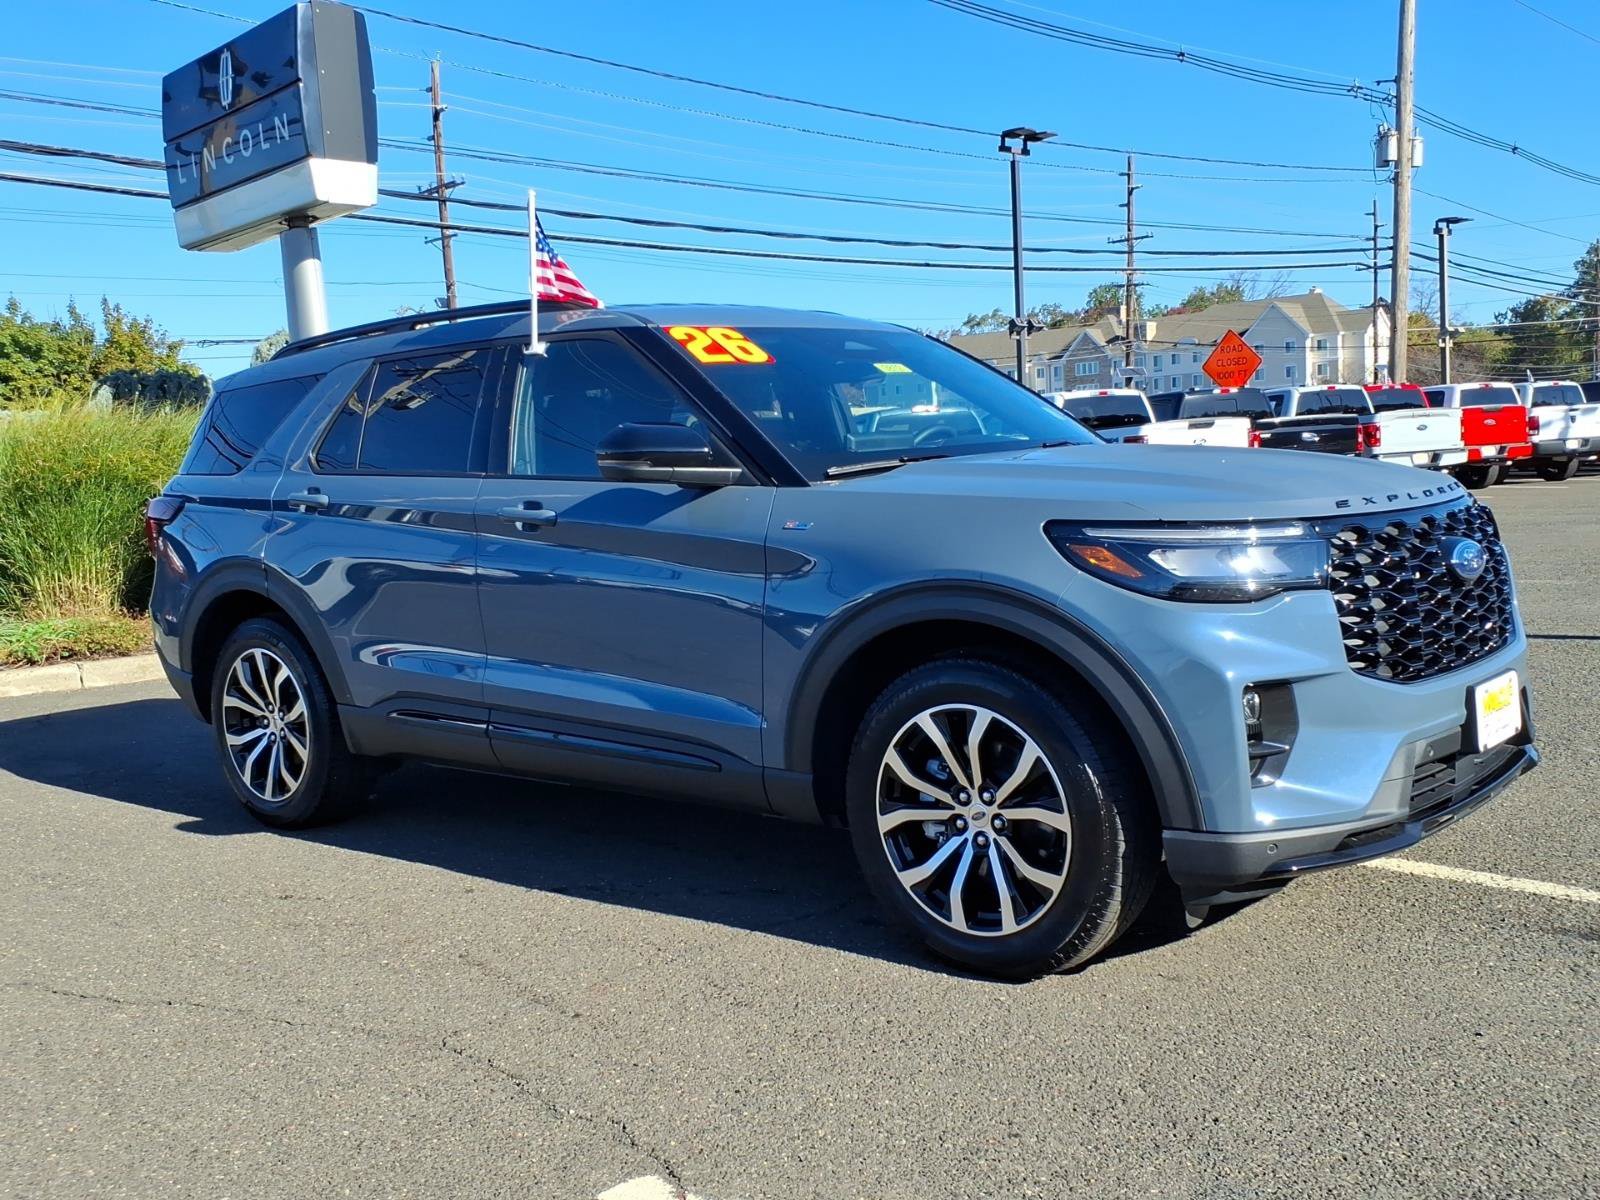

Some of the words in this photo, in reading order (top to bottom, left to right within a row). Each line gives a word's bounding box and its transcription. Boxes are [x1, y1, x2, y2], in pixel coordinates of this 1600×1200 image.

[177, 113, 290, 184] LINCOLN
[669, 326, 769, 363] 26
[1220, 344, 1243, 354] ROAD
[1216, 357, 1248, 367] CLOSED
[1216, 371, 1235, 380] 1000
[1237, 369, 1249, 378] FT
